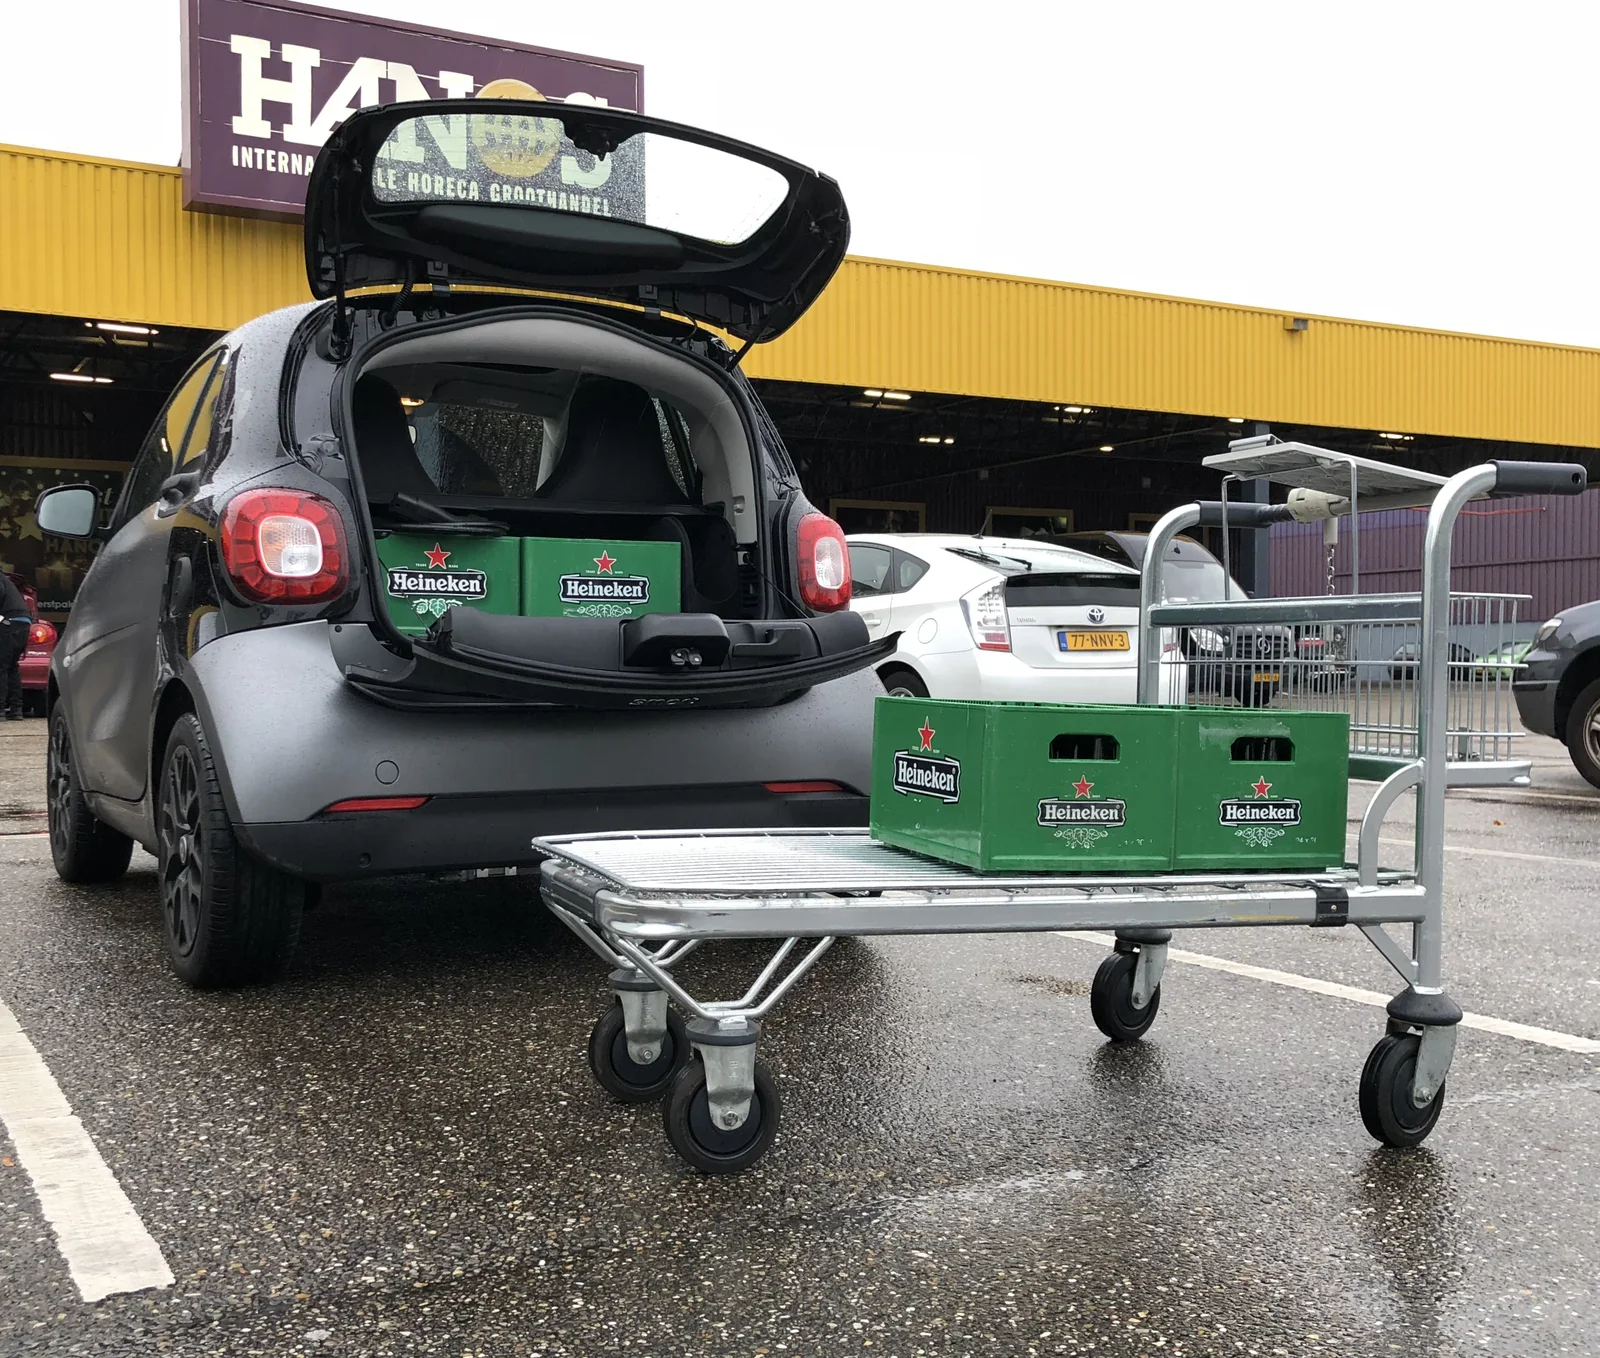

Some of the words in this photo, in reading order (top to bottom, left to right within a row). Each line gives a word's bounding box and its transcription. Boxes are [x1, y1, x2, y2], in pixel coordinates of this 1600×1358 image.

[408, 172, 479, 200] HORECA
[490, 183, 611, 216] GROOTHANDEL
[392, 573, 481, 592] Heineken
[566, 581, 643, 597] Heineken
[1071, 634, 1125, 648] 77-NNV-3
[898, 760, 955, 792] Heineken
[1044, 804, 1120, 820] Heineken
[1225, 805, 1296, 820] Heineken
